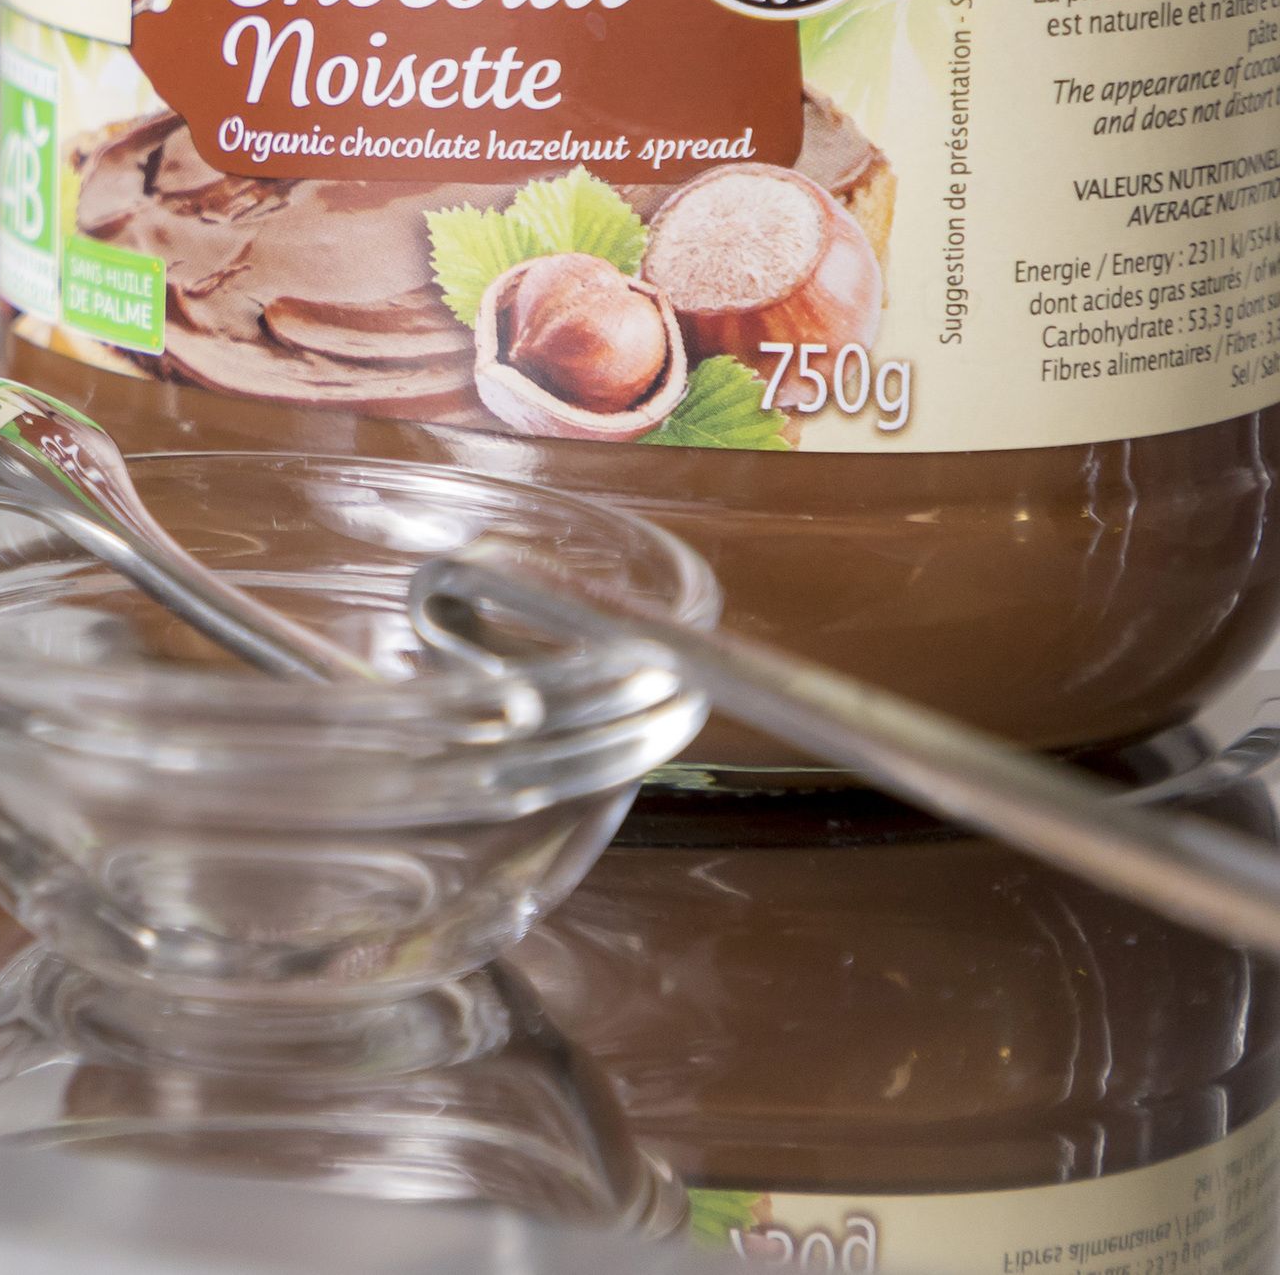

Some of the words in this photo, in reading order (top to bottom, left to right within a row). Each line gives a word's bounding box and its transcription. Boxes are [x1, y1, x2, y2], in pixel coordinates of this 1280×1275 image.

[1046, 14, 1083, 37] est
[1089, 2, 1183, 34] naturelle
[1188, 1, 1206, 24] et
[221, 14, 563, 110] Noisette
[1053, 77, 1095, 105] The
[1100, 68, 1221, 106] appearance
[1224, 56, 1244, 89] of
[944, 30, 973, 176] présentation
[1092, 105, 1138, 136] and
[1140, 104, 1188, 131] does
[1192, 99, 1222, 125] not
[1224, 87, 1274, 119] distort
[218, 115, 336, 163] Organic
[339, 125, 480, 160] chocolate
[486, 129, 631, 161] hazelnut
[637, 127, 757, 170] spread
[943, 182, 967, 211] de
[1073, 171, 1164, 201] VALEURS
[1127, 194, 1215, 227] AVERAGE
[104, 267, 153, 298] HUILE
[939, 218, 969, 345] Suggestion
[1014, 257, 1091, 286] Energie
[1113, 252, 1175, 277] Energy
[1188, 237, 1225, 265] 2311
[68, 281, 90, 314] DE
[92, 290, 153, 331] PALME
[1029, 291, 1078, 316] dont
[1083, 285, 1143, 312] acides
[1148, 283, 1185, 311] gras
[1190, 266, 1242, 299] saturés
[1042, 317, 1174, 348] Carbohydrate
[1188, 303, 1221, 332] 53,3
[758, 341, 911, 431] 750g
[1041, 356, 1102, 382] Fibres
[1107, 343, 1212, 377] alimentaires
